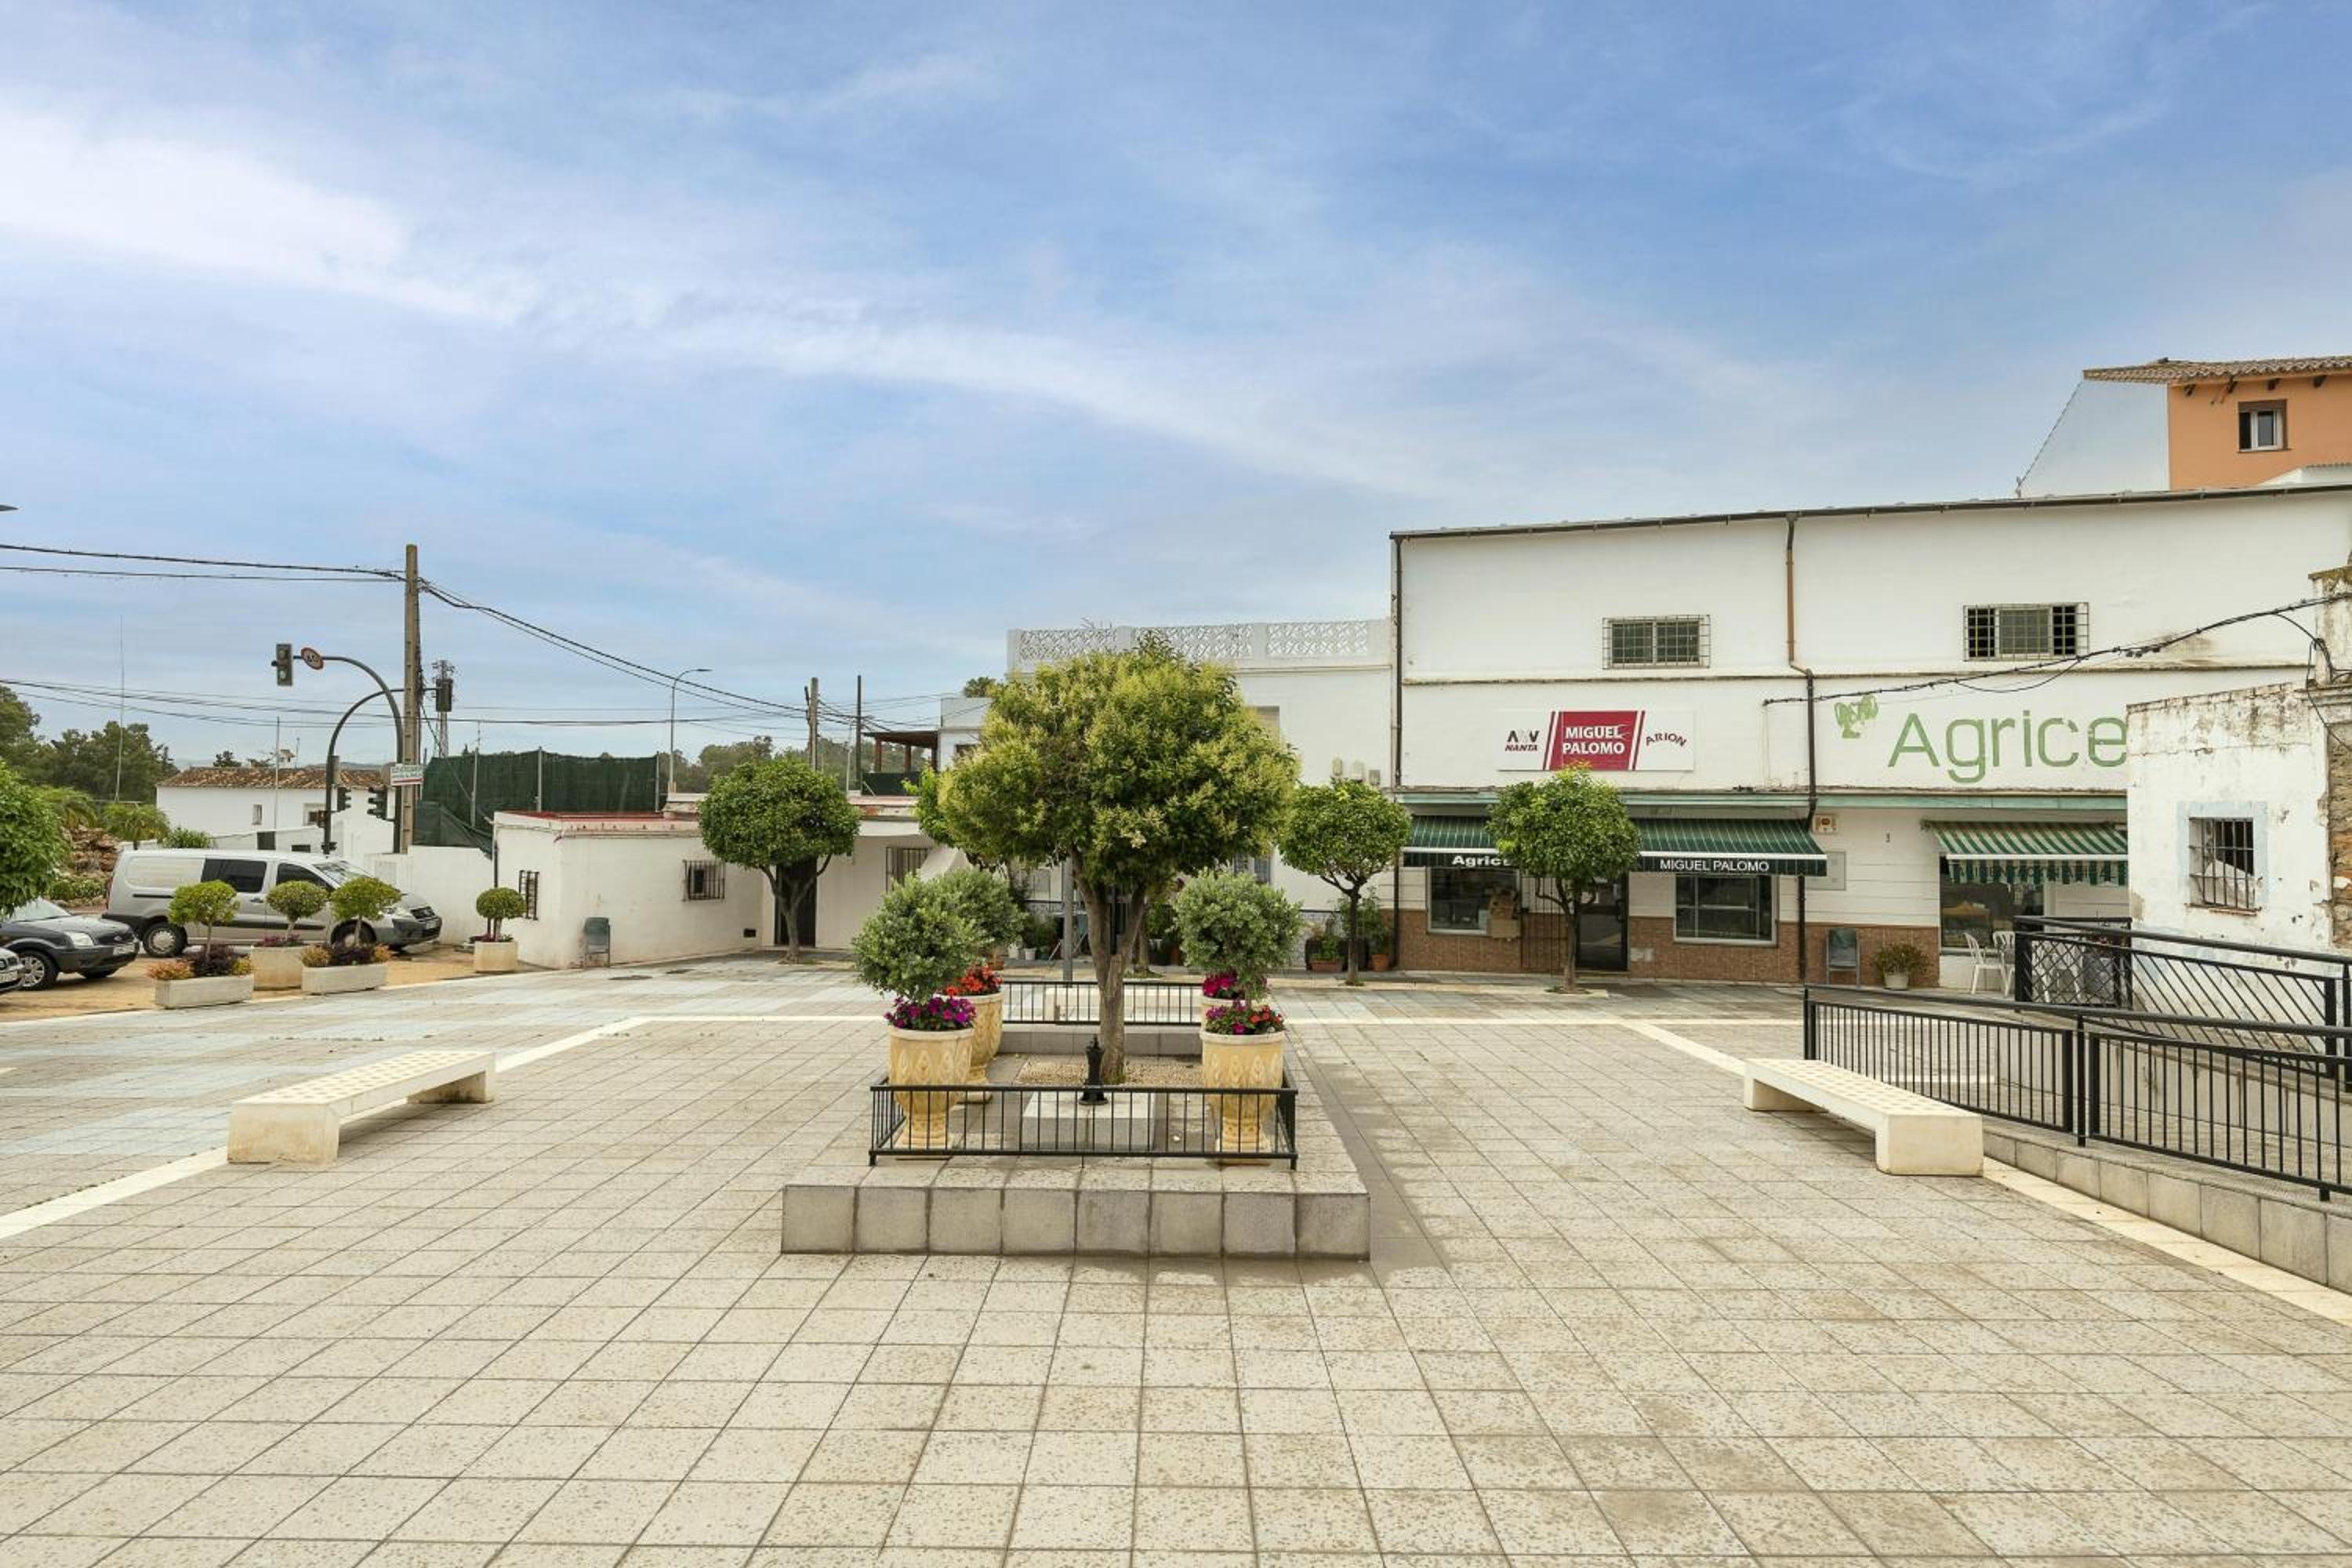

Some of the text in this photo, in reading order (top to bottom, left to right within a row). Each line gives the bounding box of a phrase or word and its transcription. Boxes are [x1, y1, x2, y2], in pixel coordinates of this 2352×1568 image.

[1566, 726, 1624, 739] MIGUEL
[1646, 732, 1687, 747] ARION
[1563, 742, 1625, 755] PALOMO
[1660, 858, 1769, 873] MIGUEL PALOMO
